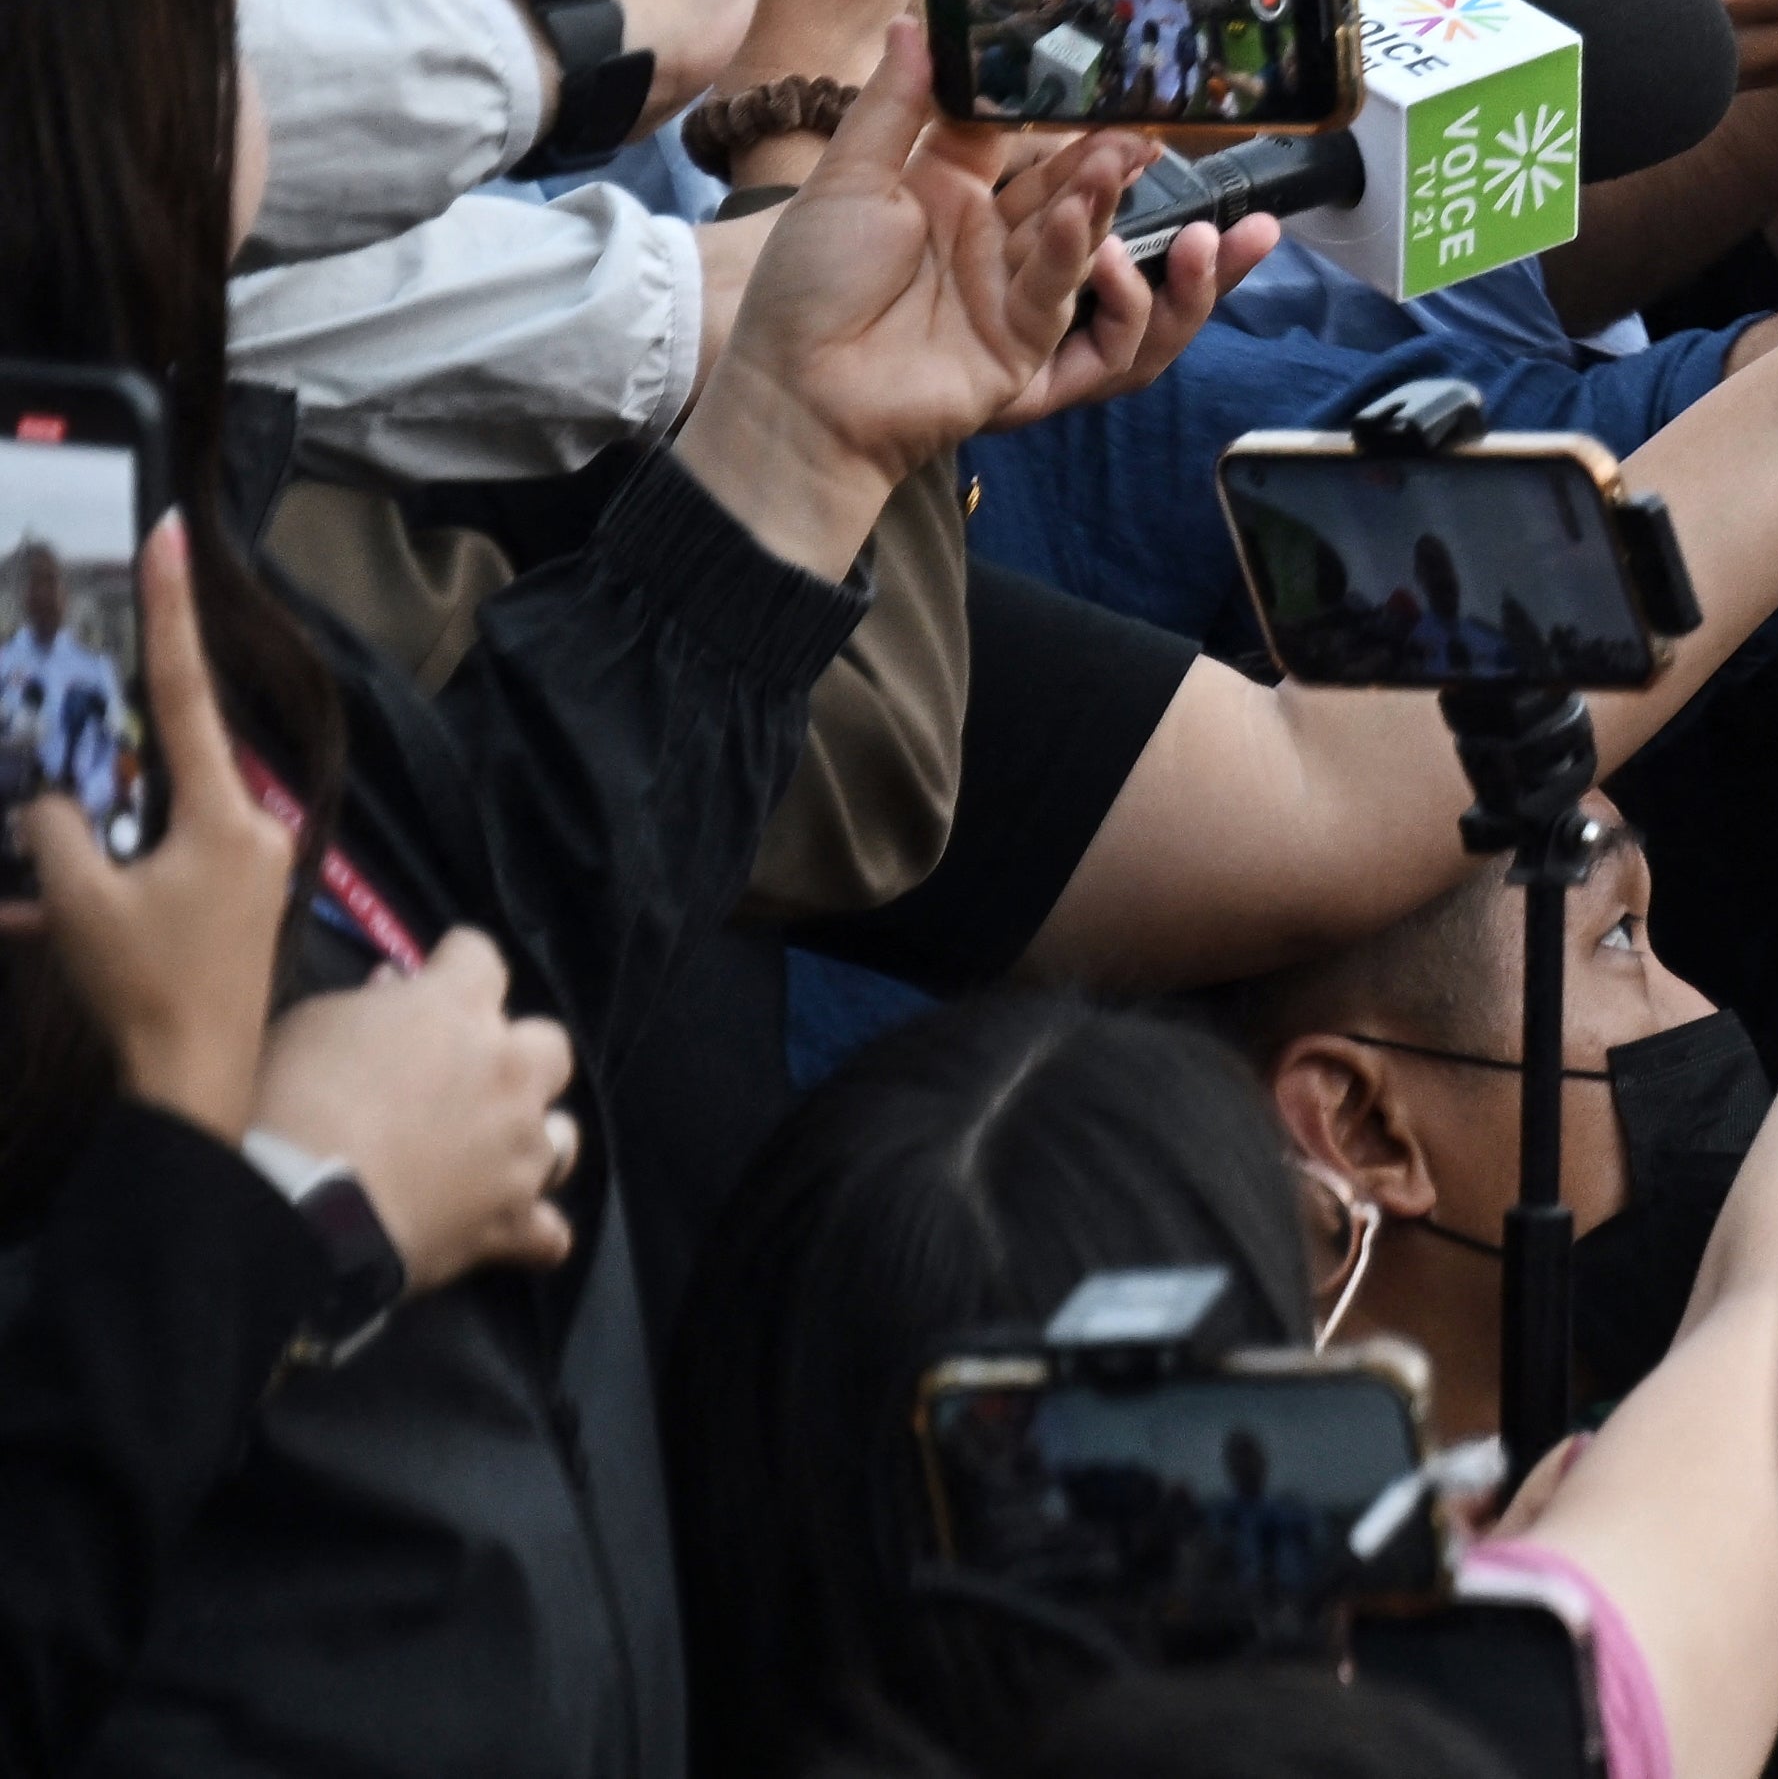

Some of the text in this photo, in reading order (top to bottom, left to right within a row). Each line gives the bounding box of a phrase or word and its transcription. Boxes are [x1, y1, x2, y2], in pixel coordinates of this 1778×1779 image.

[1359, 13, 1450, 77] OICE
[1412, 156, 1436, 241] TV 21
[1439, 105, 1480, 267] VOICE
